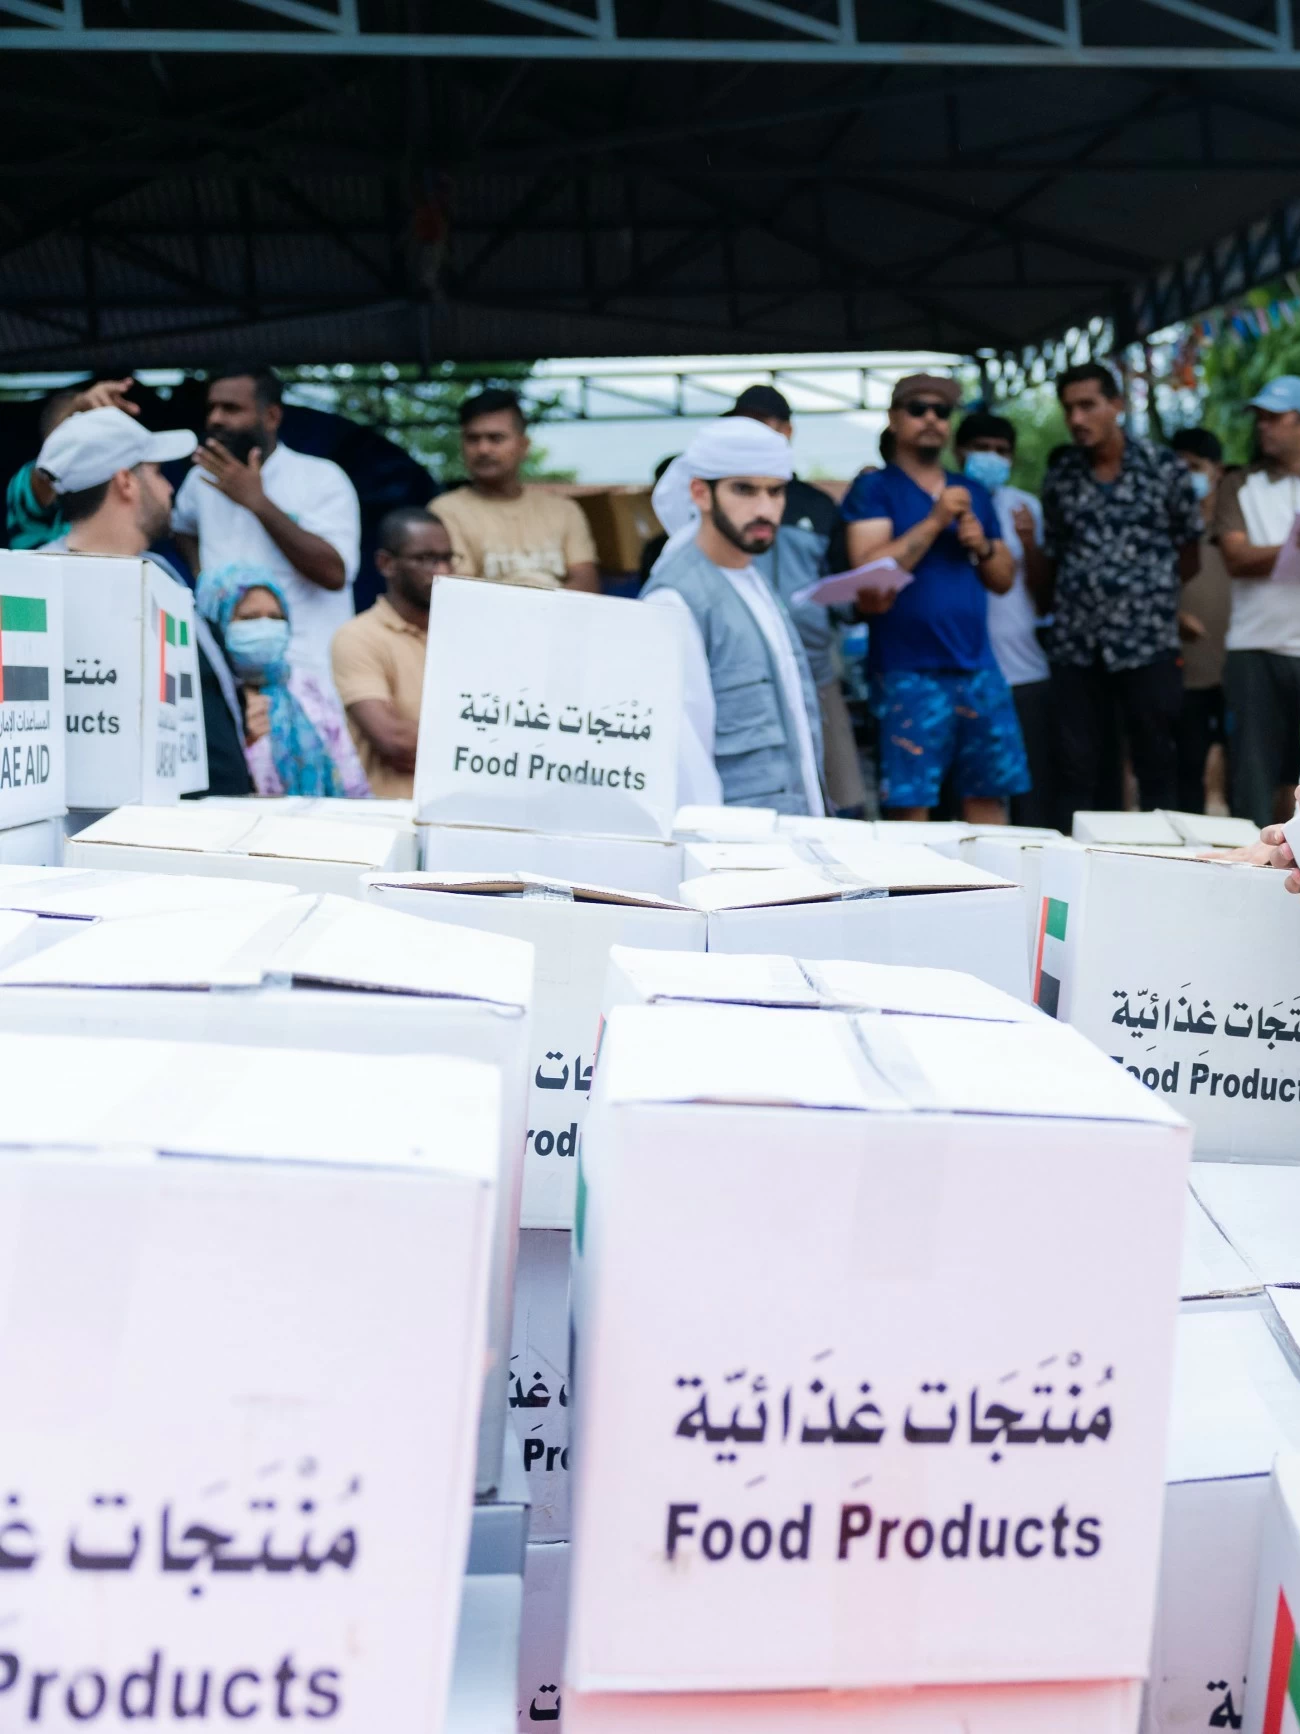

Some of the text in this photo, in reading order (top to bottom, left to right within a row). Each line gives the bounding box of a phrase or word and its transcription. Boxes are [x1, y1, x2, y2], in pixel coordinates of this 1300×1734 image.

[66, 711, 120, 734] ucts
[0, 744, 50, 789] AE AID
[453, 746, 646, 791] Food Products
[665, 1502, 1102, 1562] Food Products
